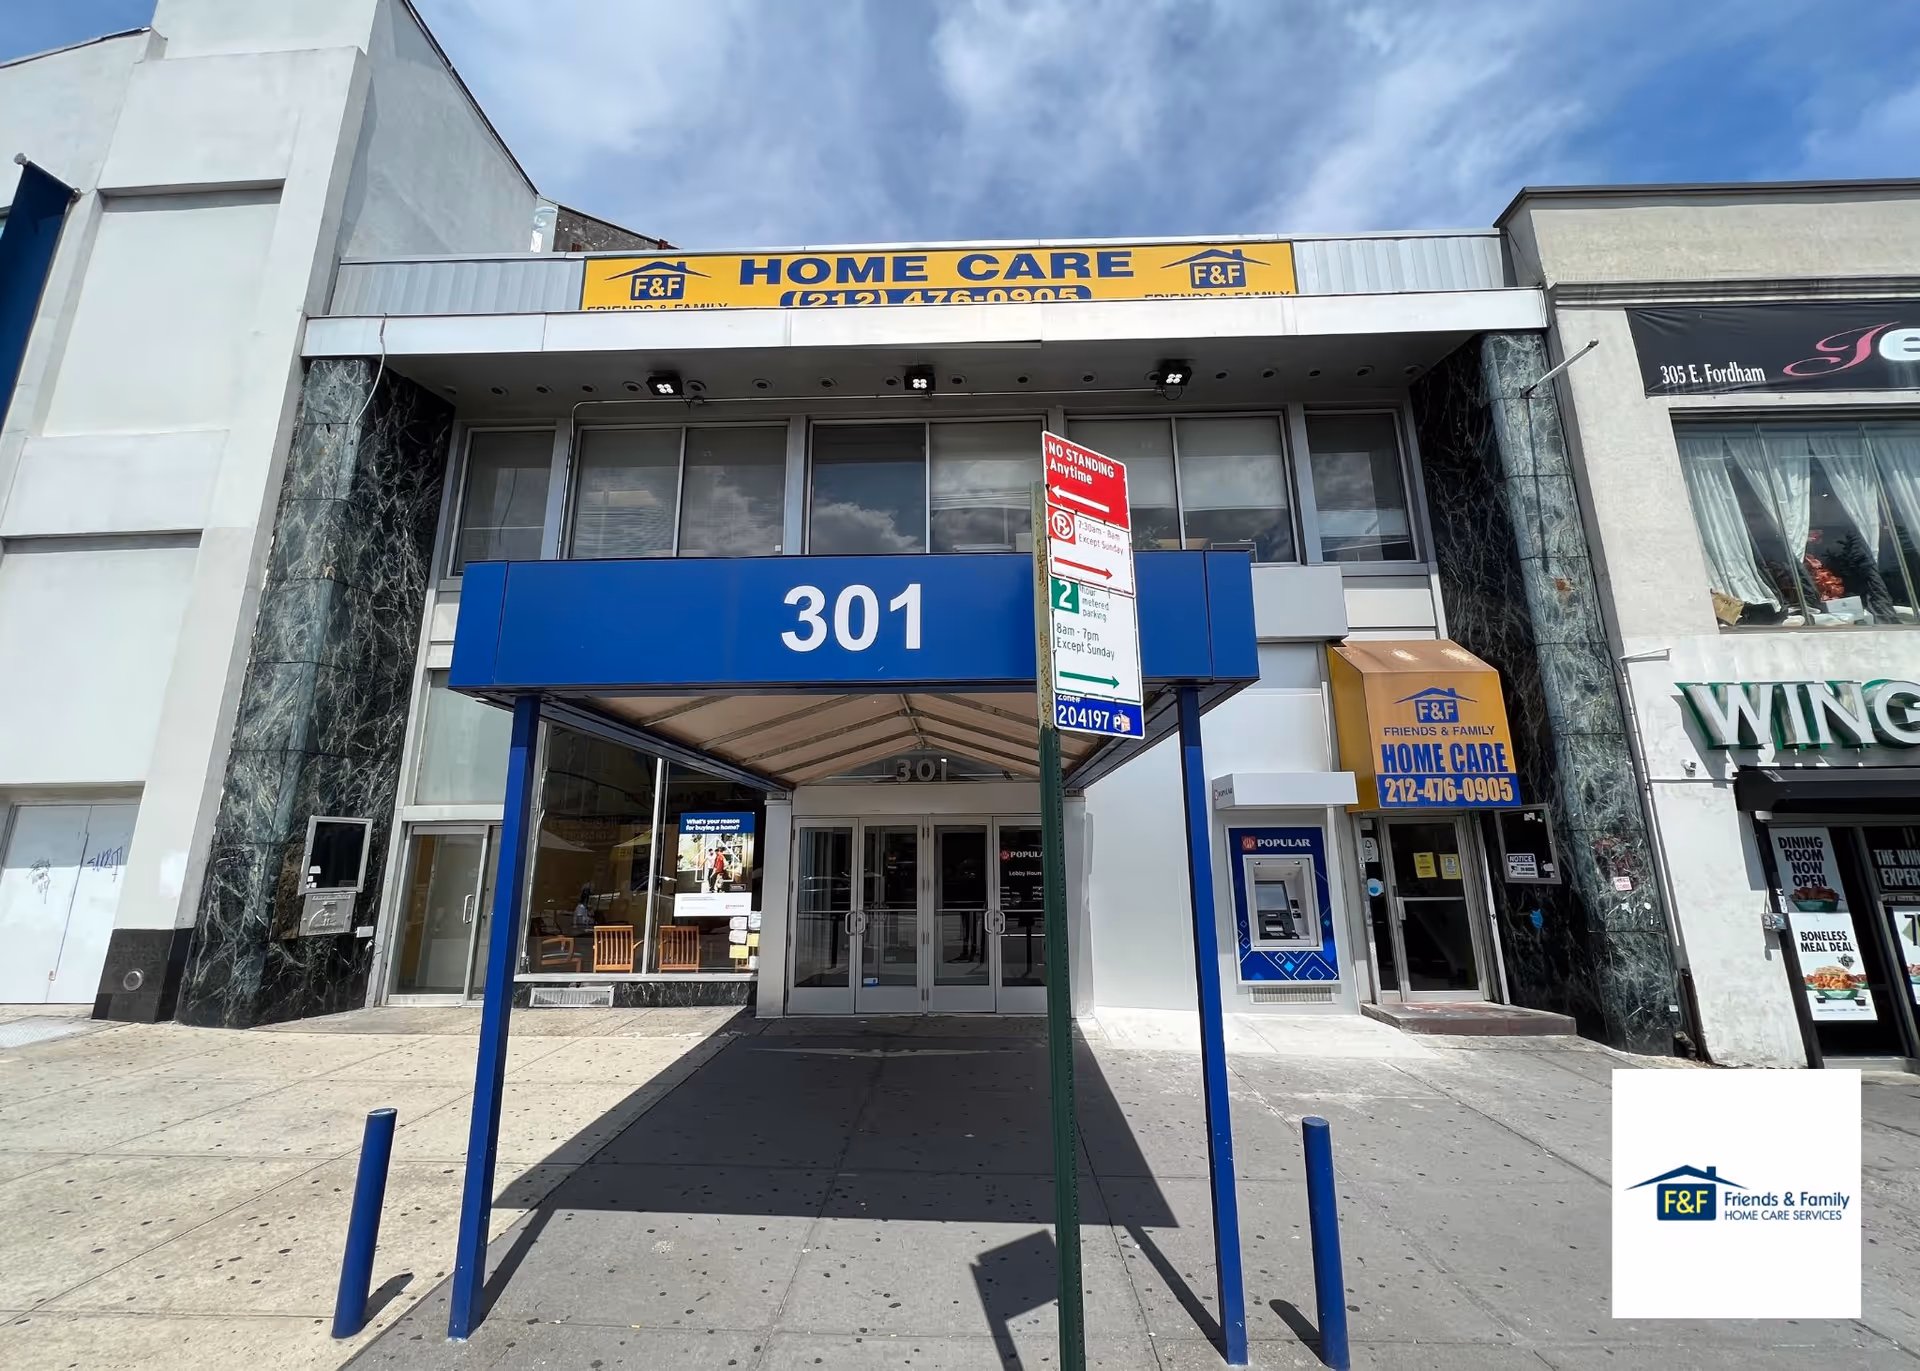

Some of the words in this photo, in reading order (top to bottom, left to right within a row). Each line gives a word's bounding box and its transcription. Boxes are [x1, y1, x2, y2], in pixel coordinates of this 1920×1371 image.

[739, 255, 929, 286] HOME
[956, 251, 1134, 281] CARE
[1193, 264, 1241, 285] F&F
[634, 277, 681, 297] F&F
[1660, 364, 1687, 385] 305
[1689, 364, 1704, 384] E.
[1705, 362, 1766, 384] Fordham
[1048, 441, 1064, 458] NO
[1066, 447, 1115, 478] STANDING
[1049, 458, 1093, 485] Anytime
[1078, 519, 1102, 535] 7:30am
[1107, 529, 1120, 541] 8am
[1078, 533, 1100, 548] Except
[1101, 540, 1124, 556] Sunday
[1058, 580, 1072, 609] 2
[1082, 597, 1109, 611] metered
[781, 583, 922, 652] 301
[1082, 608, 1107, 624] parking
[1056, 622, 1075, 636] 8am
[1083, 627, 1100, 642] 7pm
[1056, 636, 1085, 655] Except
[1087, 642, 1115, 661] Sunday
[1057, 705, 1110, 730] 204197
[1417, 702, 1454, 720] F&F
[1383, 727, 1437, 736] FRIENDS
[1441, 726, 1449, 736] &
[1453, 725, 1495, 736] FAMILY
[1381, 743, 1446, 773] HOME
[1450, 743, 1509, 773] CARE
[896, 758, 948, 782] 301
[1384, 777, 1514, 802] 212-476-0905
[1257, 838, 1311, 848] POPULAR
[1777, 836, 1823, 849] DINING
[1784, 849, 1824, 861] ROOM
[1873, 849, 1896, 865] THE
[1791, 862, 1822, 874] NOW
[1880, 868, 1920, 886] EXPER
[1792, 875, 1827, 887] OPEN
[1800, 931, 1847, 941] BONELESS
[1800, 942, 1828, 952] MEAL
[1830, 942, 1854, 952] DEAL
